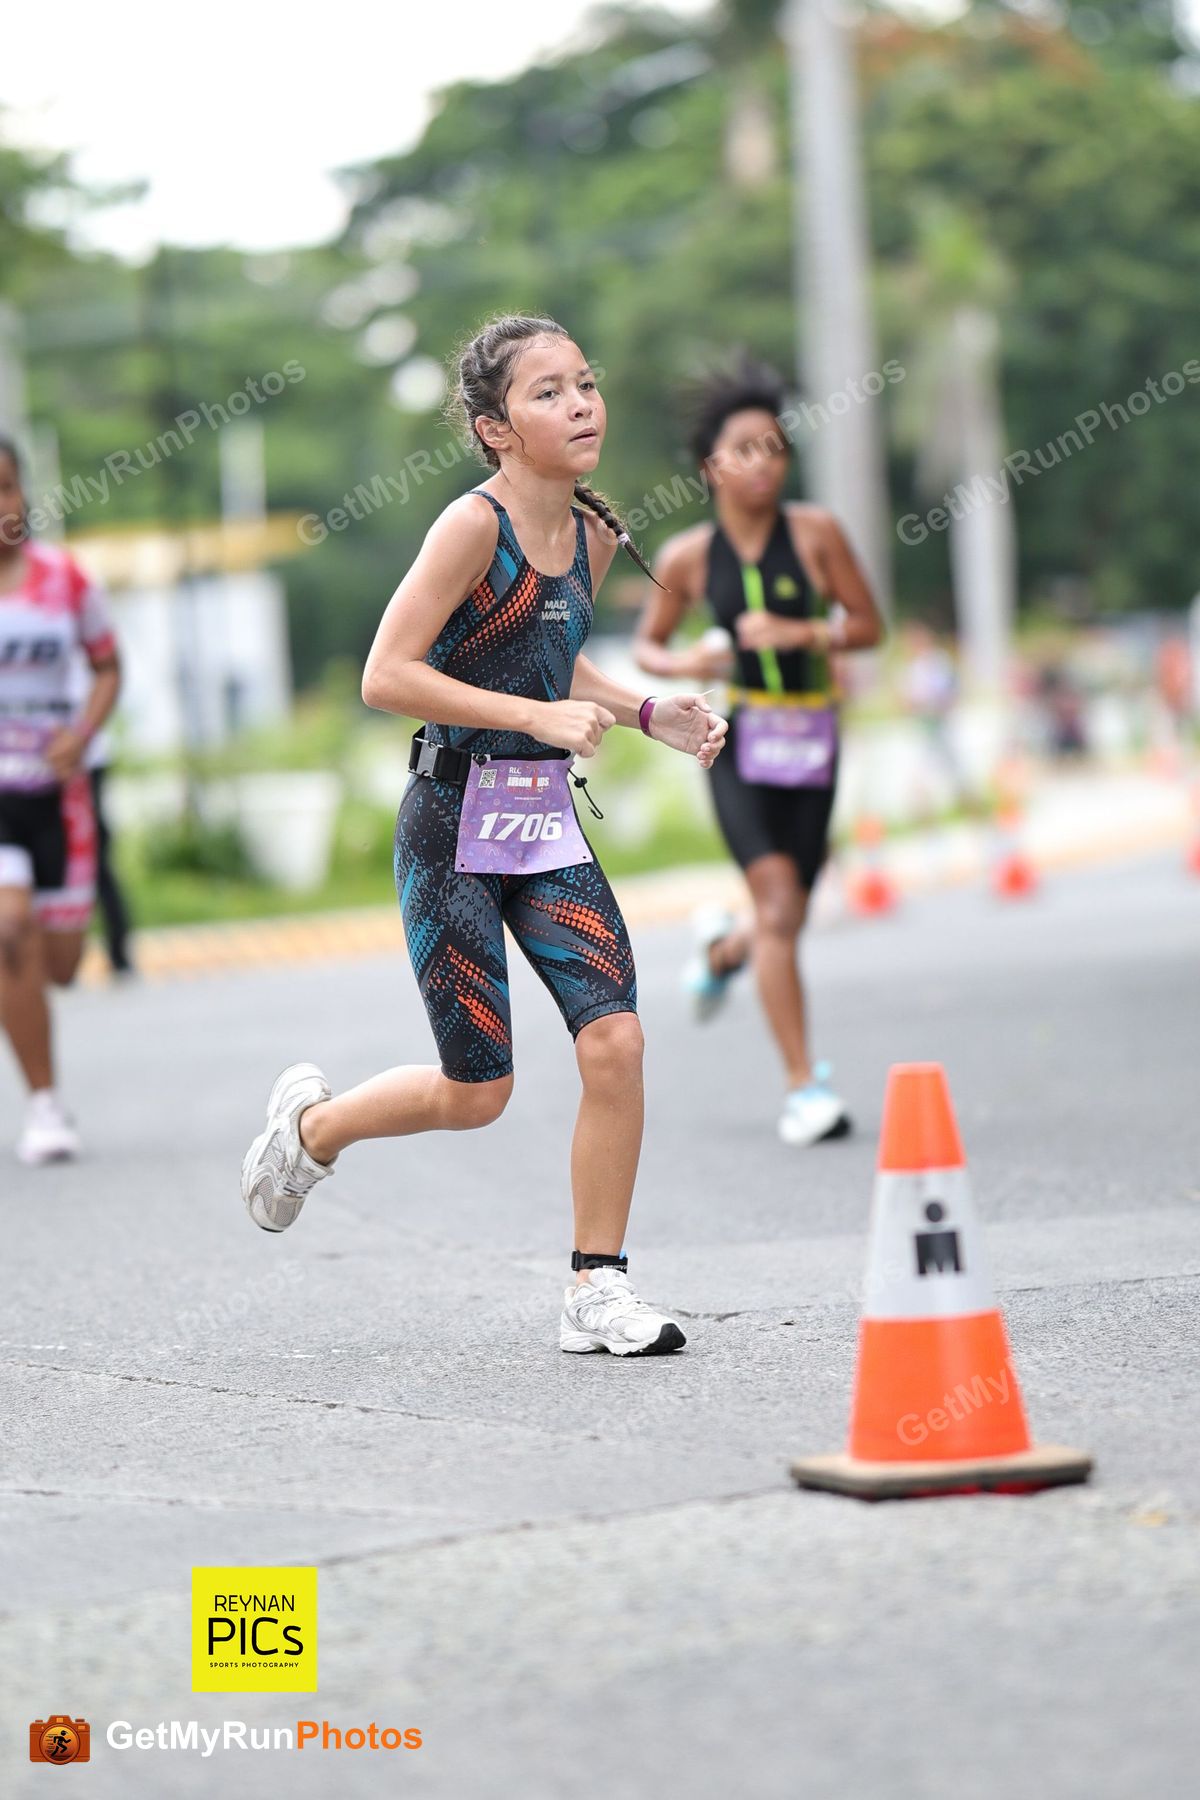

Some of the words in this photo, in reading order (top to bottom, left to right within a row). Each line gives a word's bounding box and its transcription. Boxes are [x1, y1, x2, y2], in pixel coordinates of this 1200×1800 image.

[544, 600, 568, 610] MAD
[541, 610, 571, 621] WAVE
[477, 812, 563, 842] 1706
